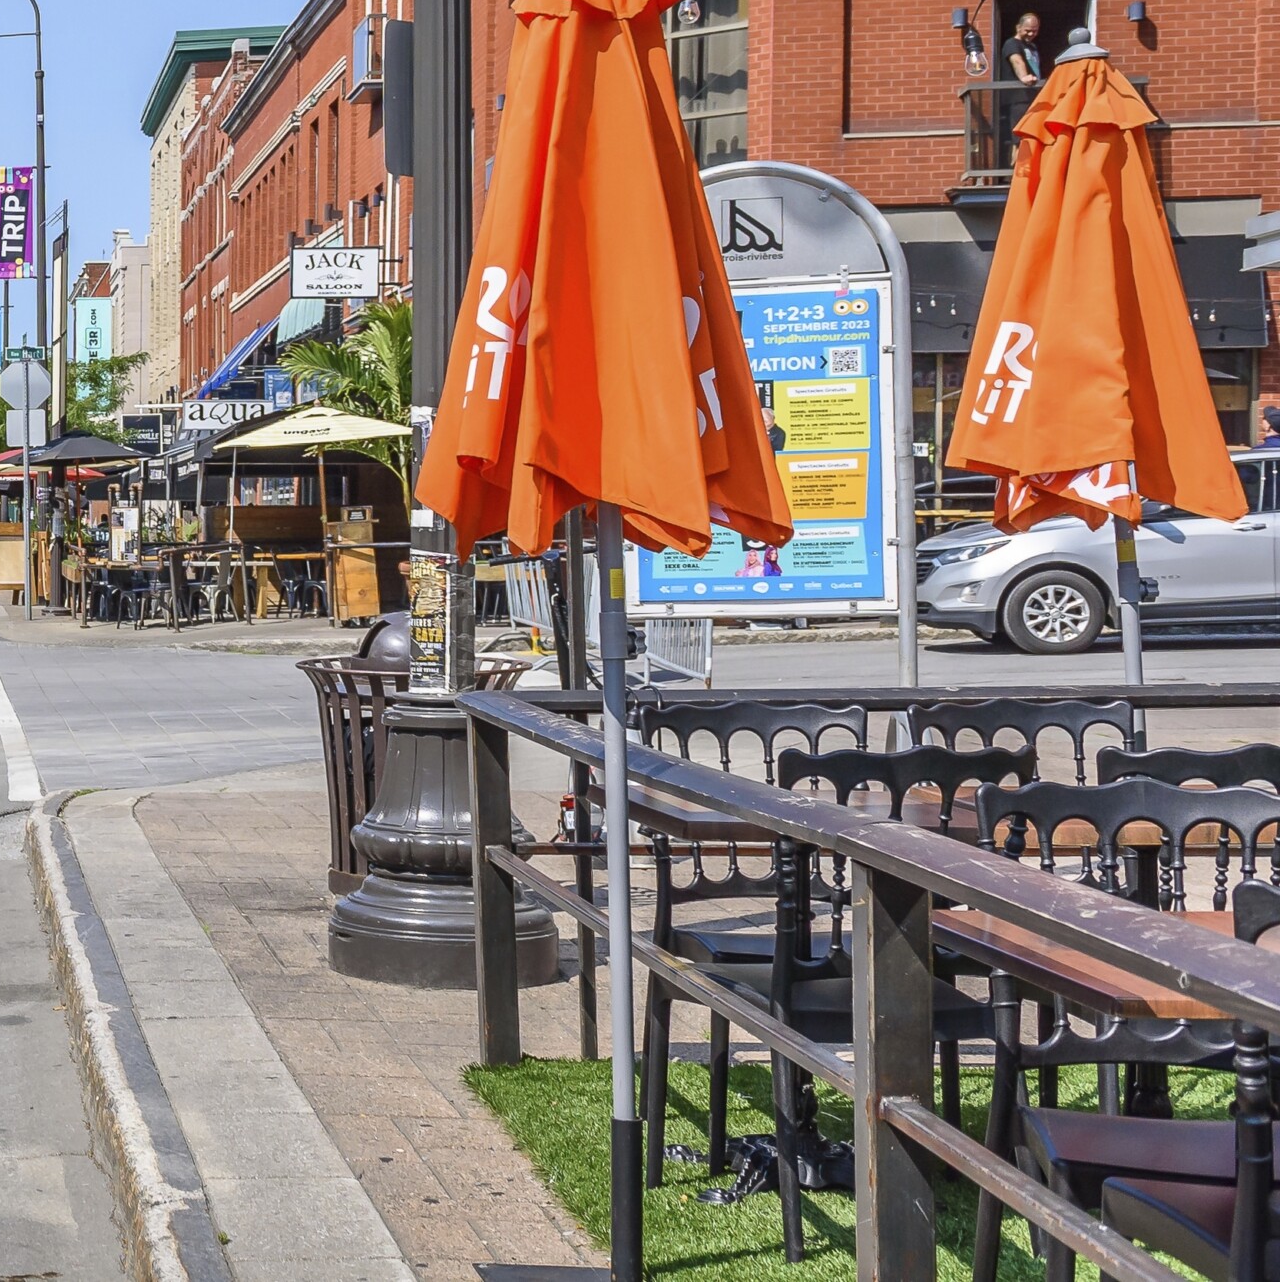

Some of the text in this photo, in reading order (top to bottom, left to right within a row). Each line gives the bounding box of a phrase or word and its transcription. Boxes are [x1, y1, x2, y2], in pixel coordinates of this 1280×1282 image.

[0, 194, 26, 258] TRIP
[305, 251, 365, 271] JACK
[763, 304, 825, 322] 1+2+3
[763, 320, 871, 334] SEPTEMBRE 2023
[763, 331, 871, 346] tripdhumour.com
[22, 349, 41, 359] Hart
[283, 426, 331, 437] ungava
